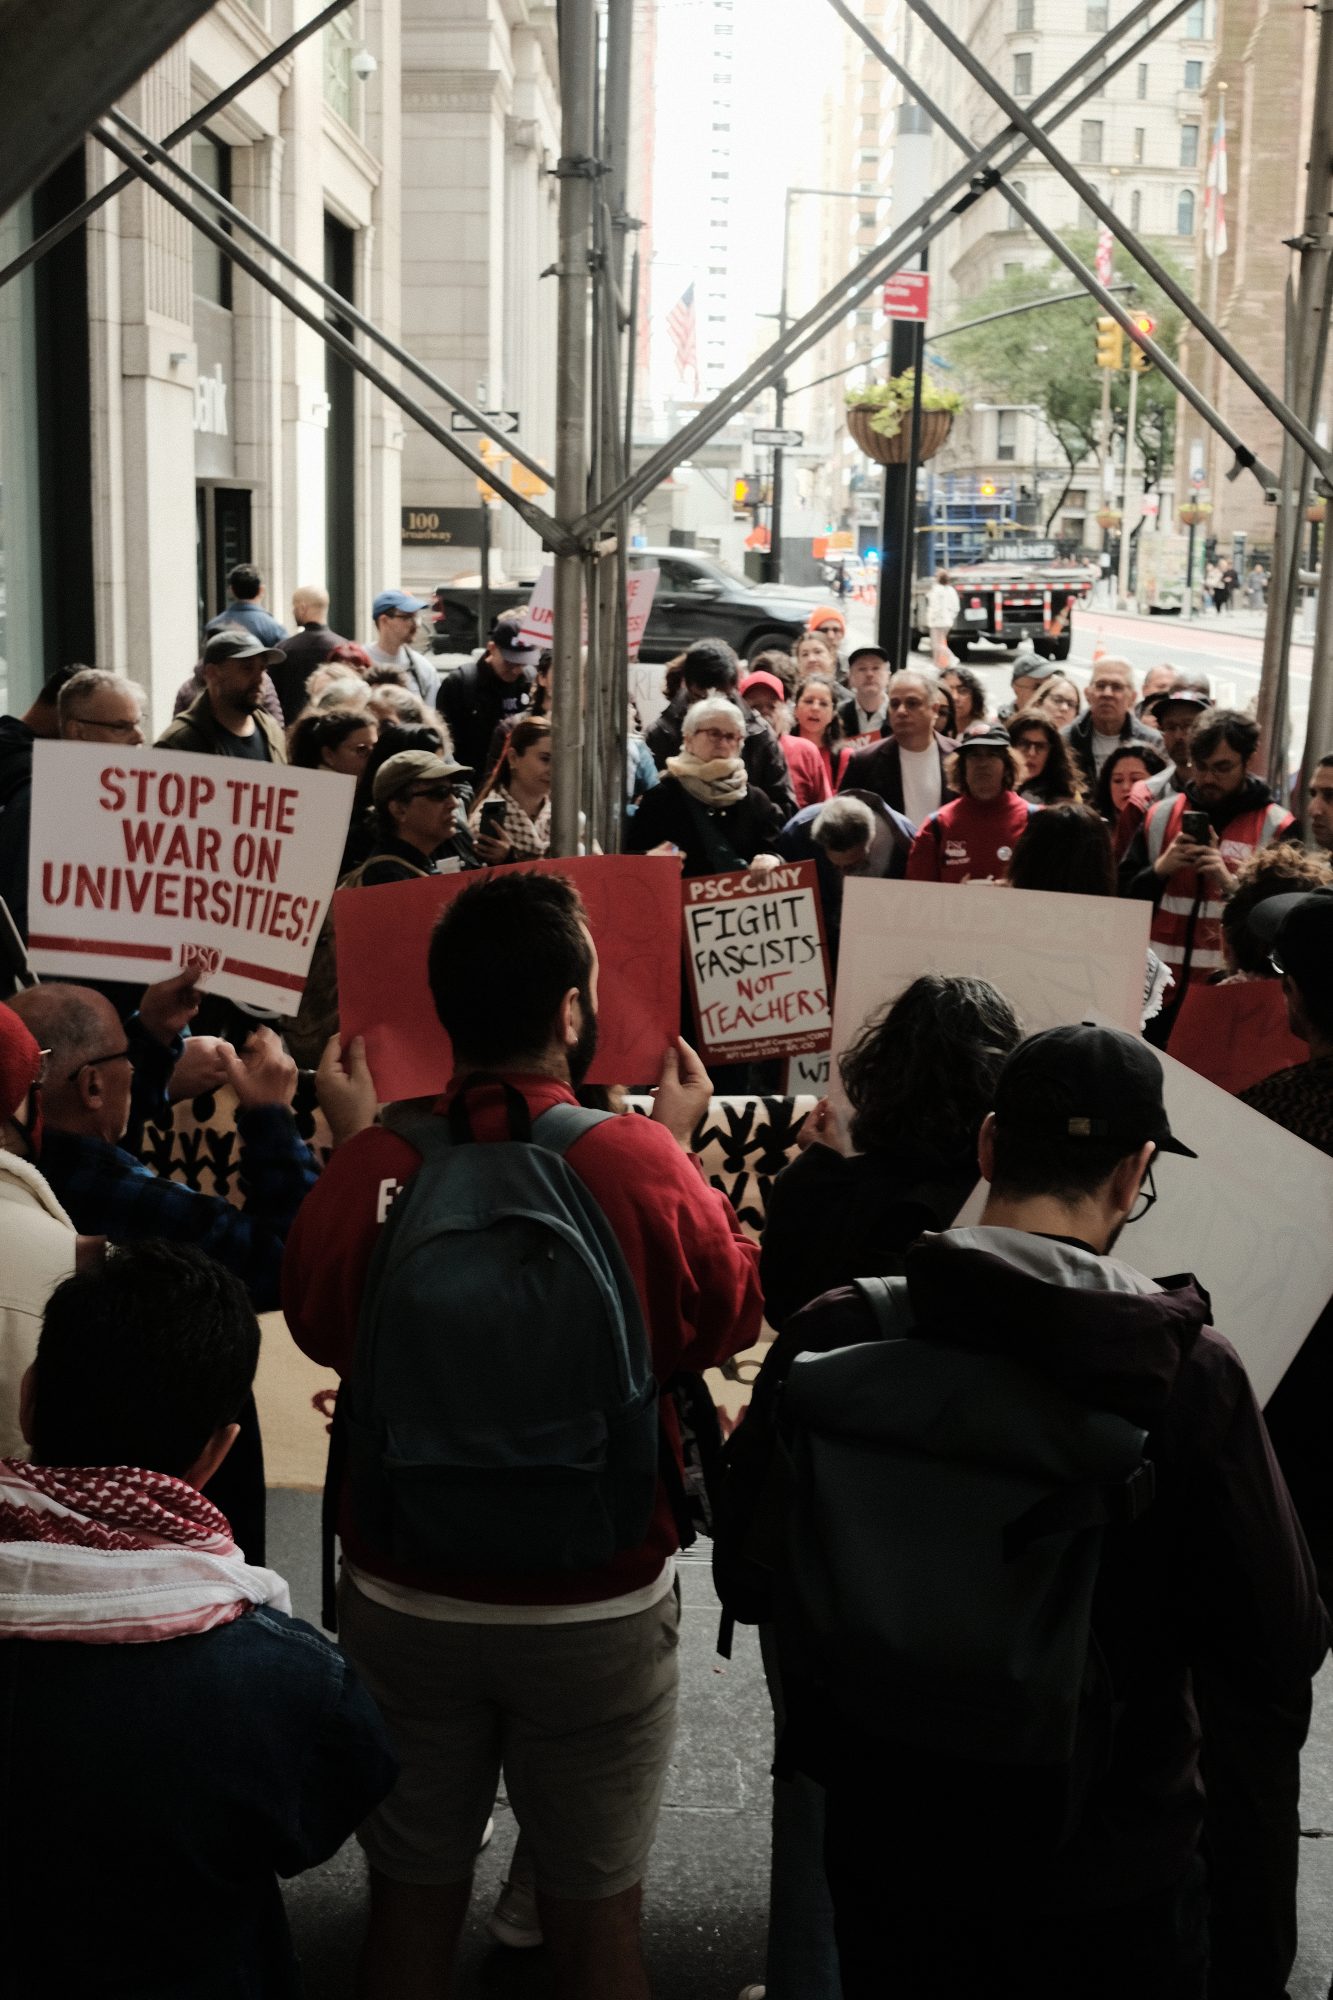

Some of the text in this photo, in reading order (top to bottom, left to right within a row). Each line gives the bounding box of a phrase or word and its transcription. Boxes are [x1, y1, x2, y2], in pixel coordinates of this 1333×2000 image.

[194, 362, 228, 435] ank
[408, 512, 439, 530] 100
[988, 544, 1055, 560] JIMENEZ
[99, 766, 300, 834] STOP THE
[122, 818, 282, 883] WAR ON
[41, 861, 320, 948] UNIVERSITIES!
[689, 867, 802, 901] PSC-CUNY
[691, 896, 805, 944] FIGHT
[736, 971, 793, 1001] NOT
